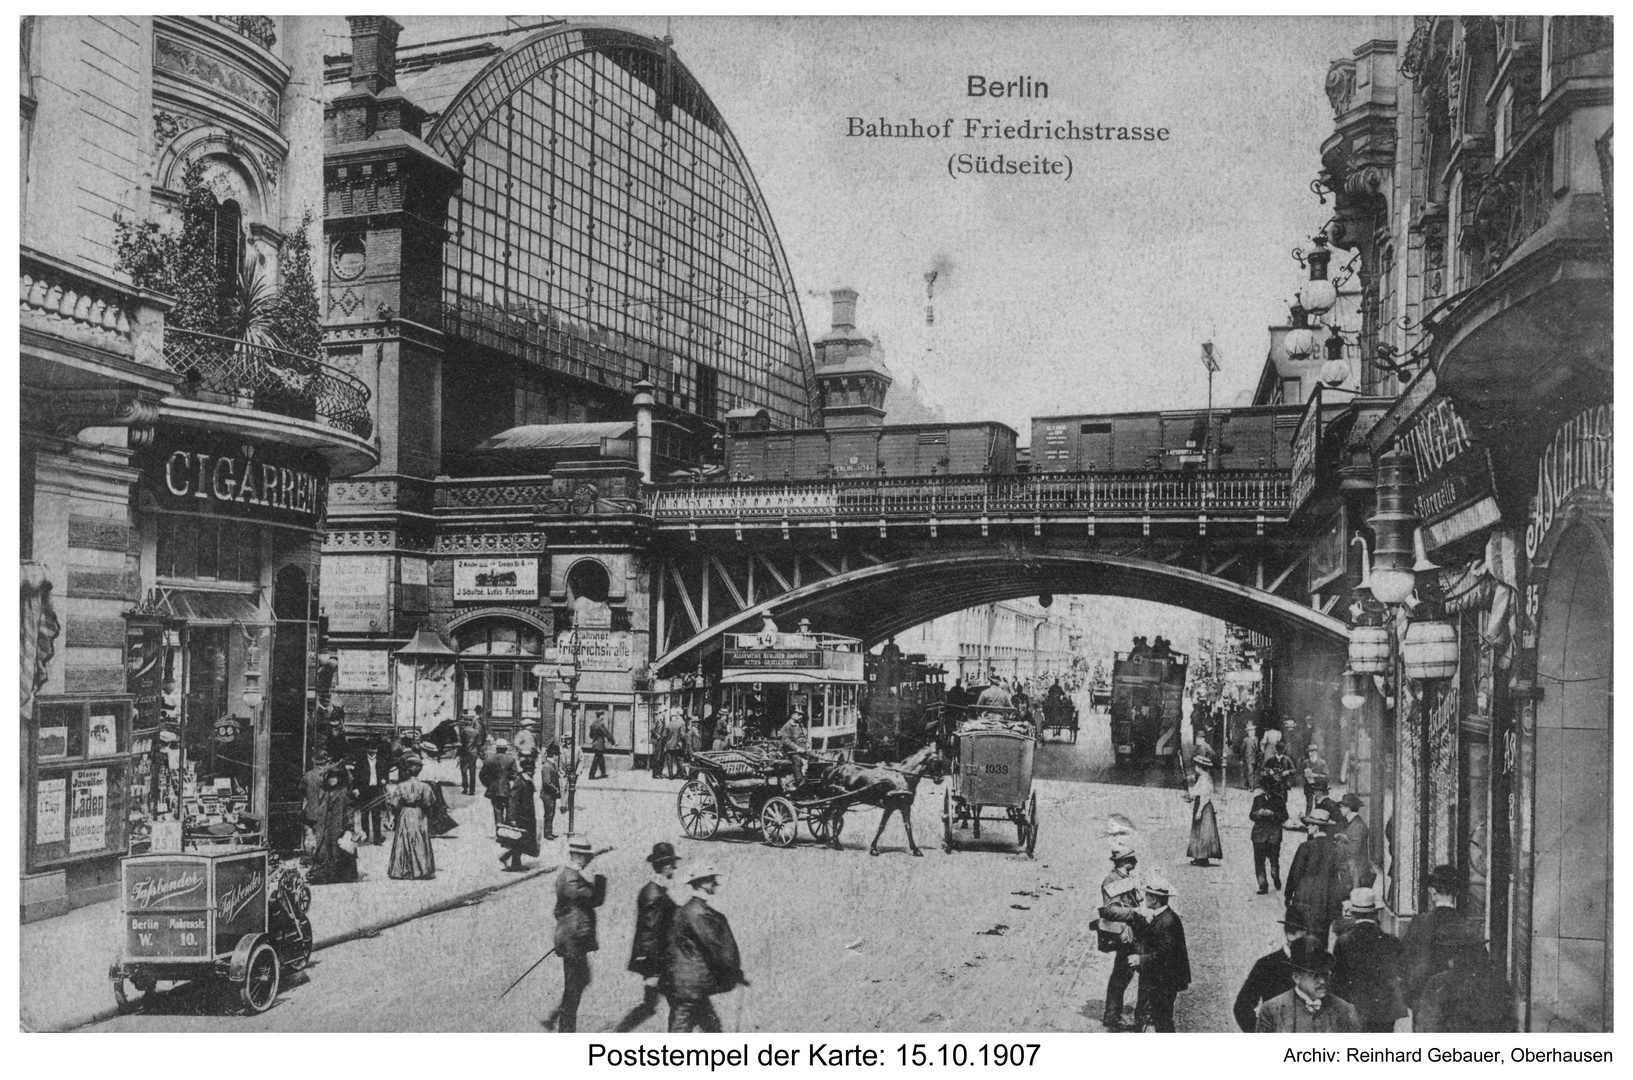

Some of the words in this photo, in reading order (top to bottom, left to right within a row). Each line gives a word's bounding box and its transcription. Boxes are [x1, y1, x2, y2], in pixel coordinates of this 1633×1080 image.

[166, 451, 317, 513] CIGARREN
[765, 633, 772, 644] 4
[77, 770, 100, 779] Dieser
[985, 764, 1009, 775] 1039
[72, 788, 104, 820] Laden
[131, 918, 160, 930] Berlin
[138, 932, 154, 947] W.
[179, 931, 198, 947] 10.
